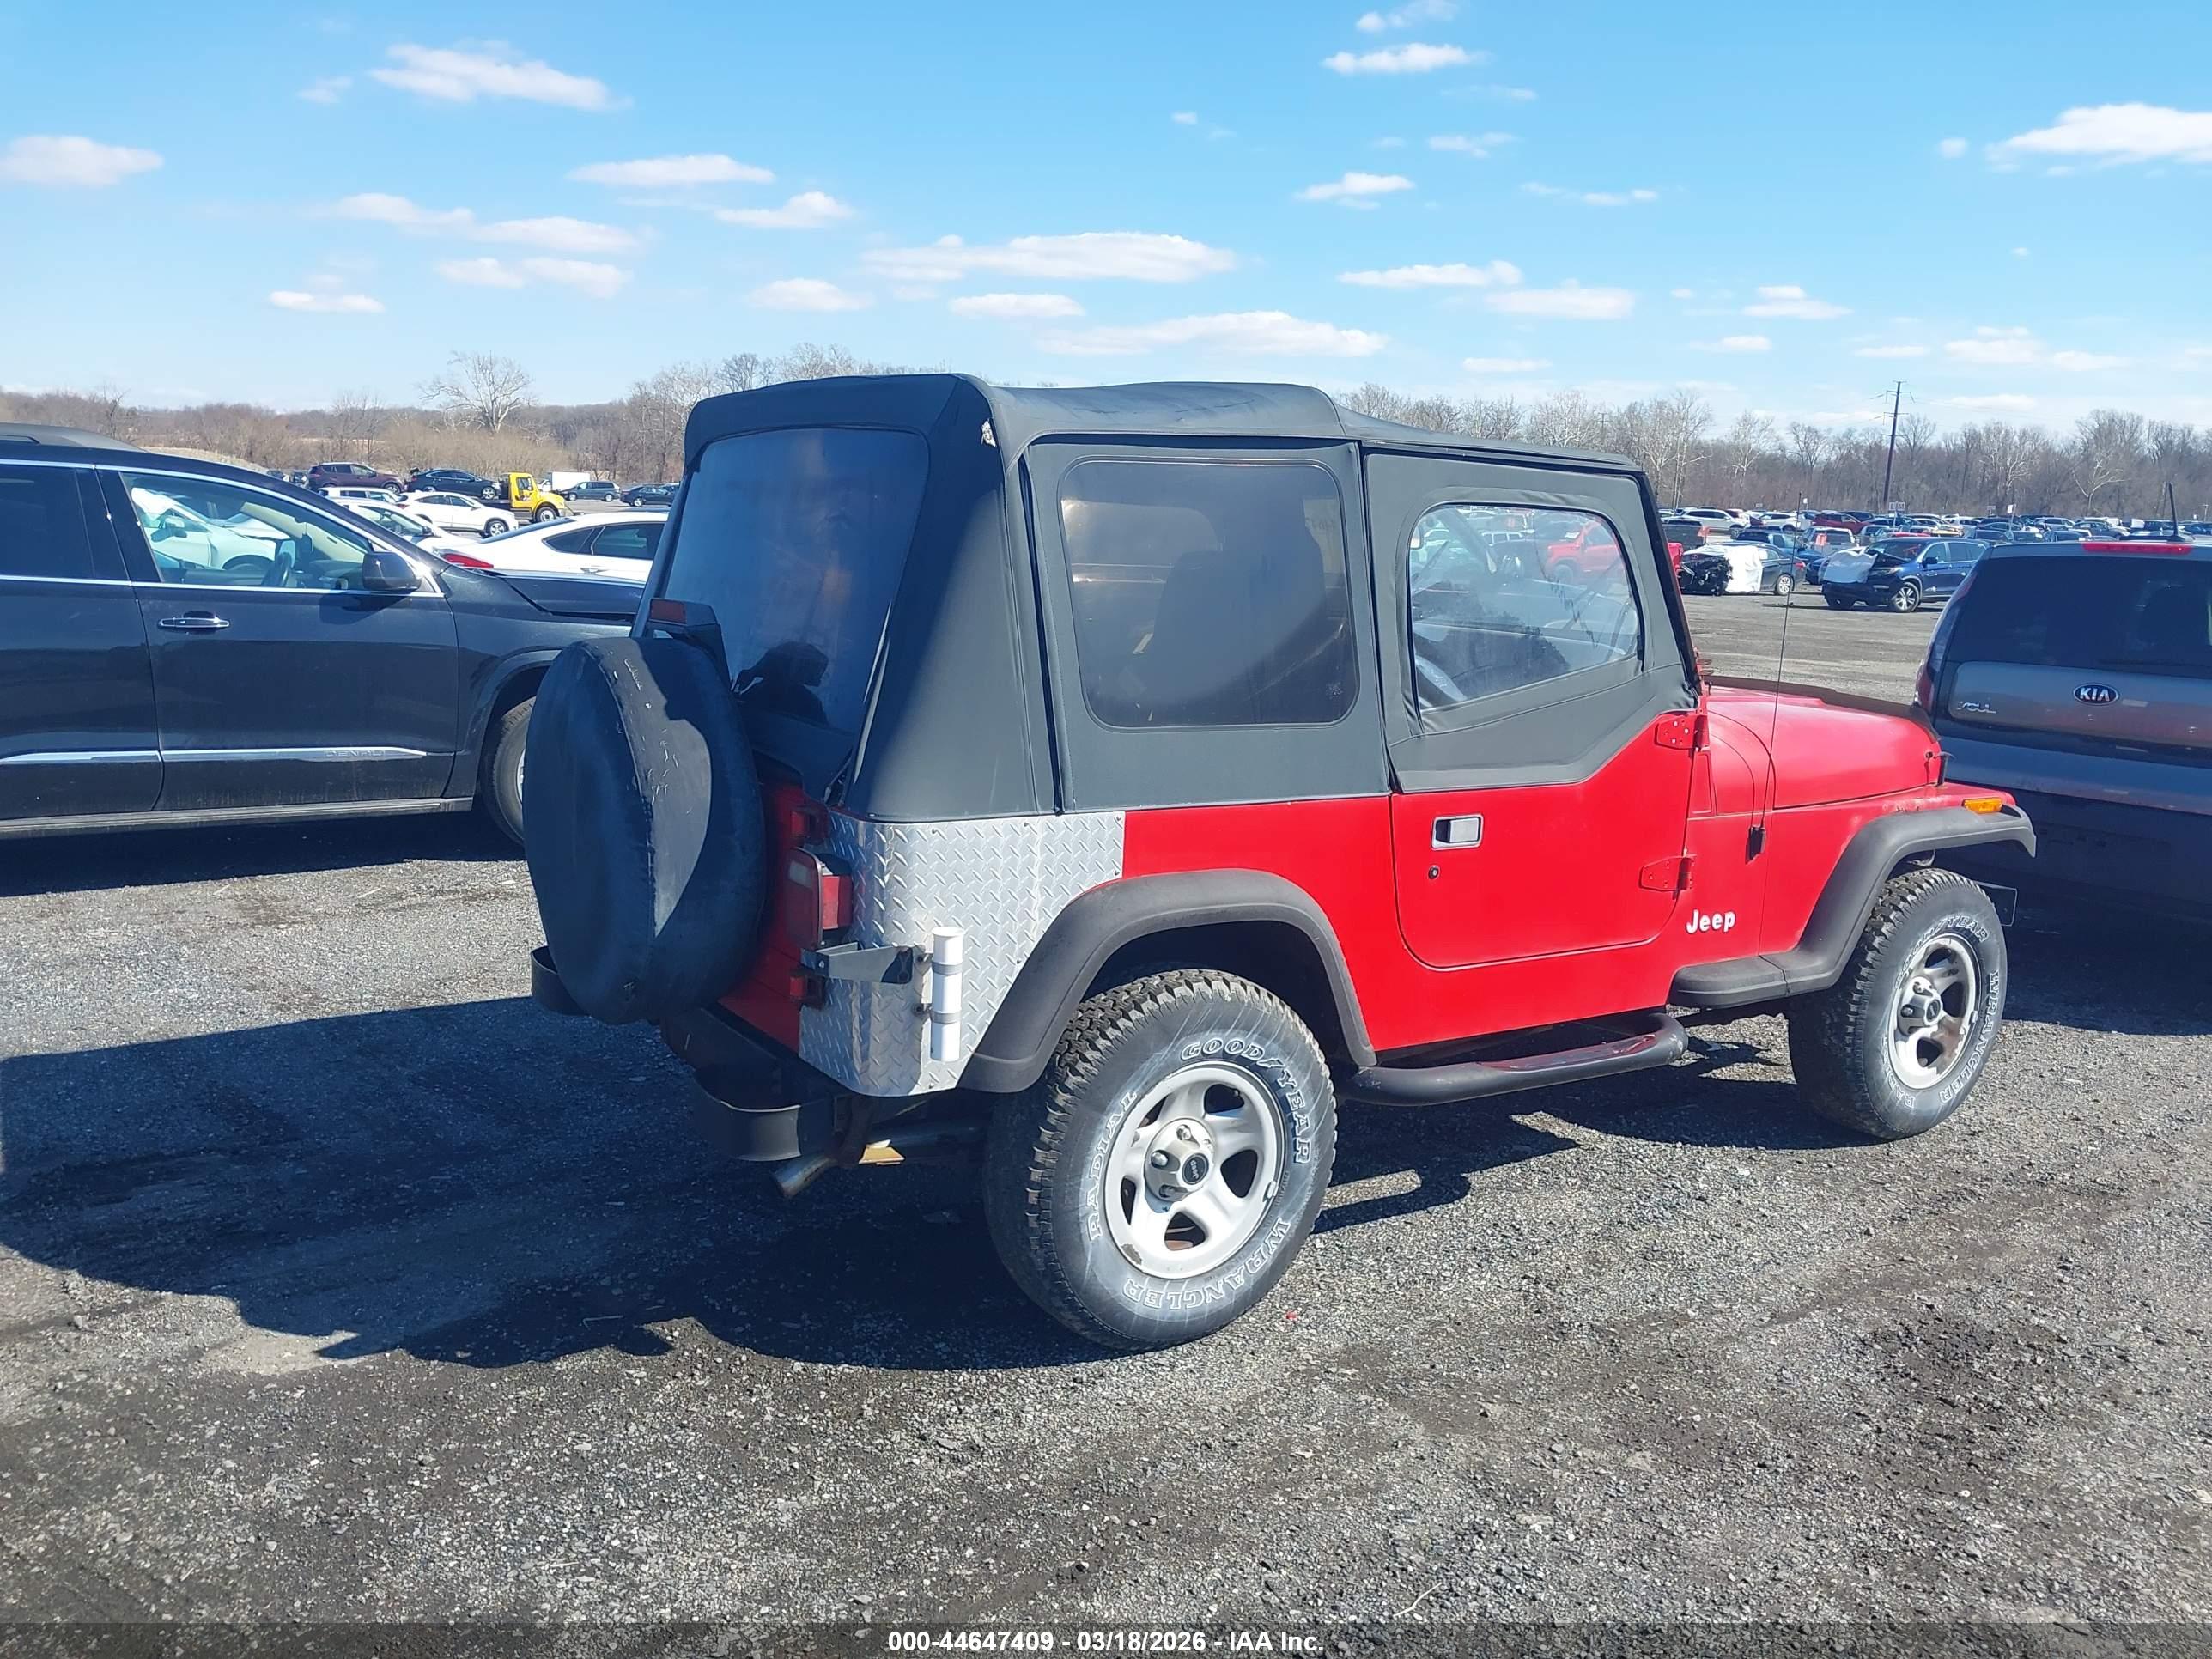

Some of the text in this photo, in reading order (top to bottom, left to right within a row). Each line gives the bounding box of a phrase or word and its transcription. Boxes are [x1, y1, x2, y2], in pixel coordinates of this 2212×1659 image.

[2080, 687, 2110, 702] KIA
[1686, 909, 1735, 934] Jeep
[1939, 969, 2000, 1103] WRANGLER
[1087, 1092, 1138, 1241] RADIAL
[1123, 1217, 1291, 1310] WRANGLER
